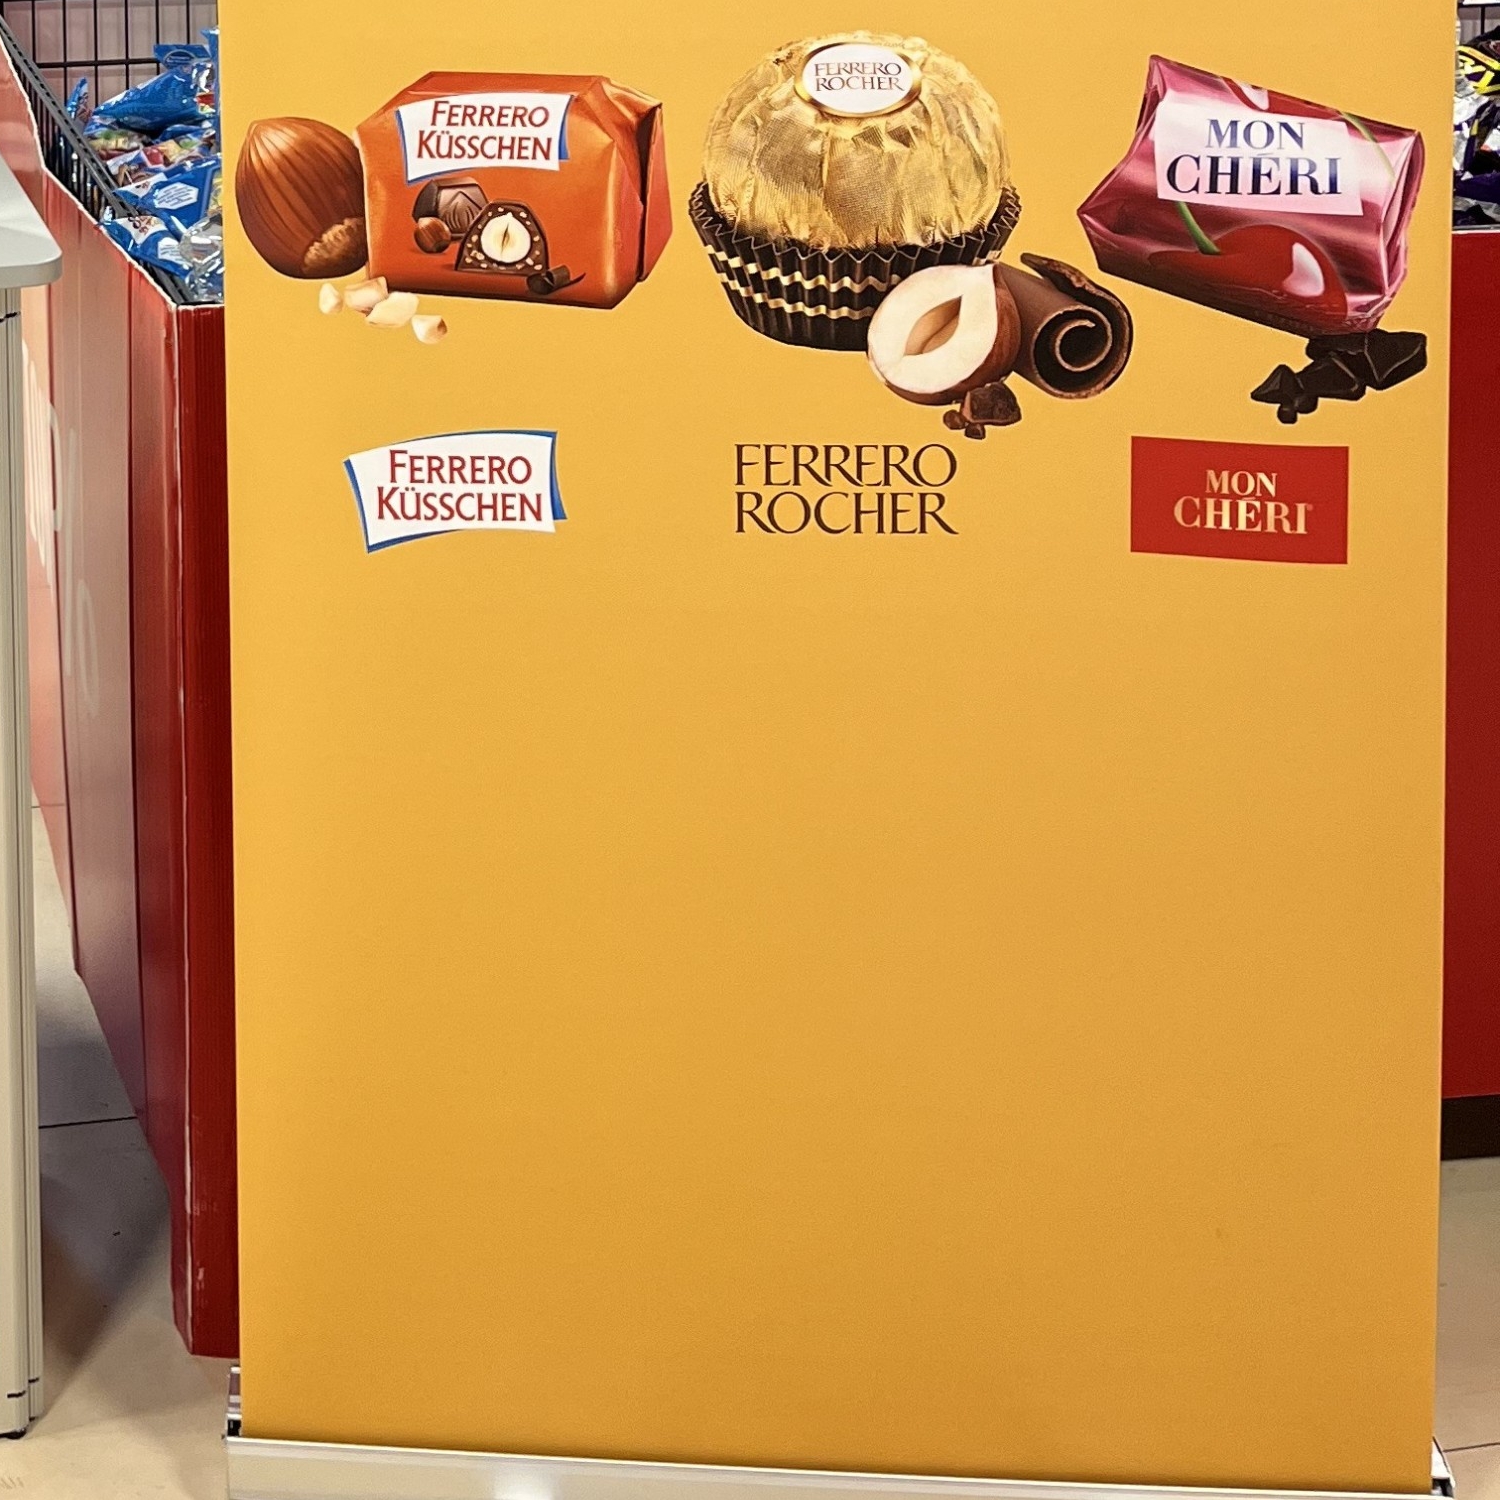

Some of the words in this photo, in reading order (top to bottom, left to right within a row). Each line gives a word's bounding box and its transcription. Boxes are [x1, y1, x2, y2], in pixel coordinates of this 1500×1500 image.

[814, 61, 902, 78] FERRERO
[815, 76, 905, 92] ROCHER
[431, 100, 549, 128] FERRERO
[417, 130, 552, 161] KÜSSCHEN
[1206, 118, 1306, 152] MON
[1166, 150, 1343, 196] CHÉRI
[389, 449, 532, 485] FERRERO
[734, 443, 957, 488] FERRERO
[1205, 469, 1278, 497] MON
[377, 486, 543, 523] KÜSSCHEN
[735, 491, 959, 535] ROCHER
